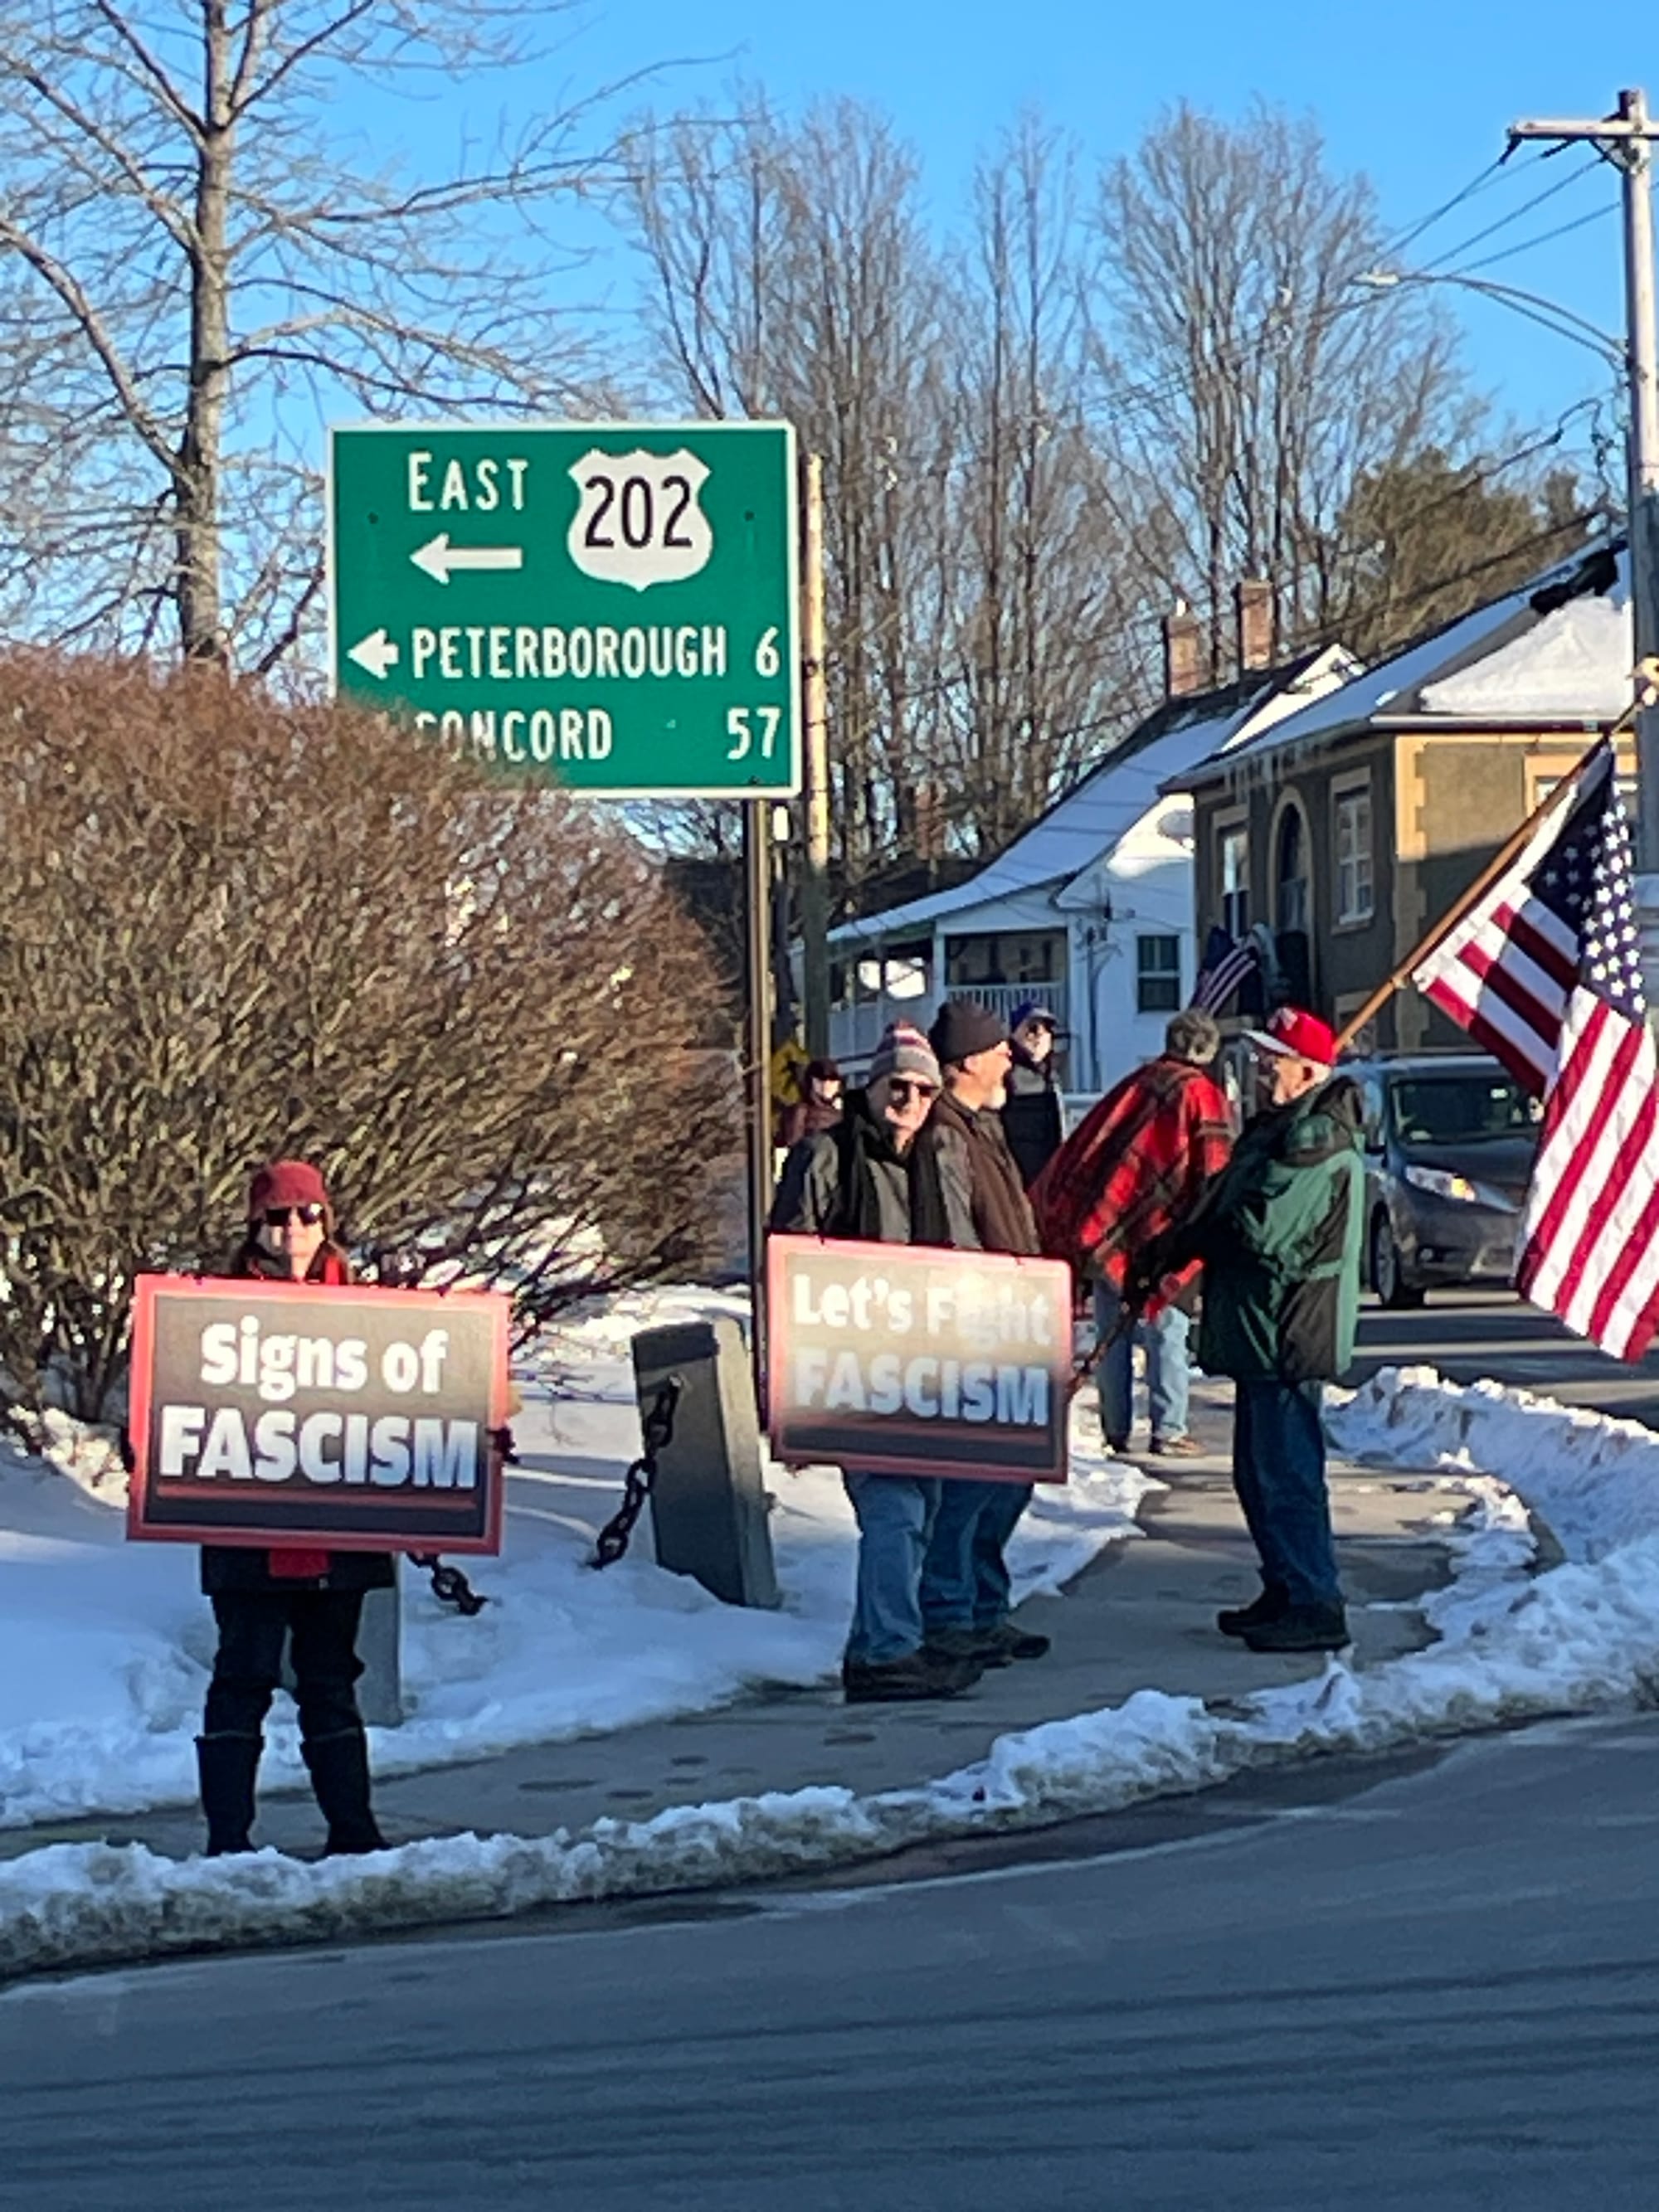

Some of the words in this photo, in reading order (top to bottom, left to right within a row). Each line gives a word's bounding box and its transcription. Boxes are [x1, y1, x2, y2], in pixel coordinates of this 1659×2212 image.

[408, 452, 528, 511] EAST
[584, 475, 693, 549] 202
[411, 625, 727, 678] PETERBOROUGH
[755, 626, 779, 678] 6
[727, 707, 781, 761] 57
[792, 1273, 912, 1334] Let's
[927, 1278, 1052, 1352] Fght
[200, 1315, 368, 1401] Signs
[382, 1329, 450, 1393] of
[794, 1346, 1049, 1426] FASCISM
[159, 1405, 479, 1489] FASCISM
